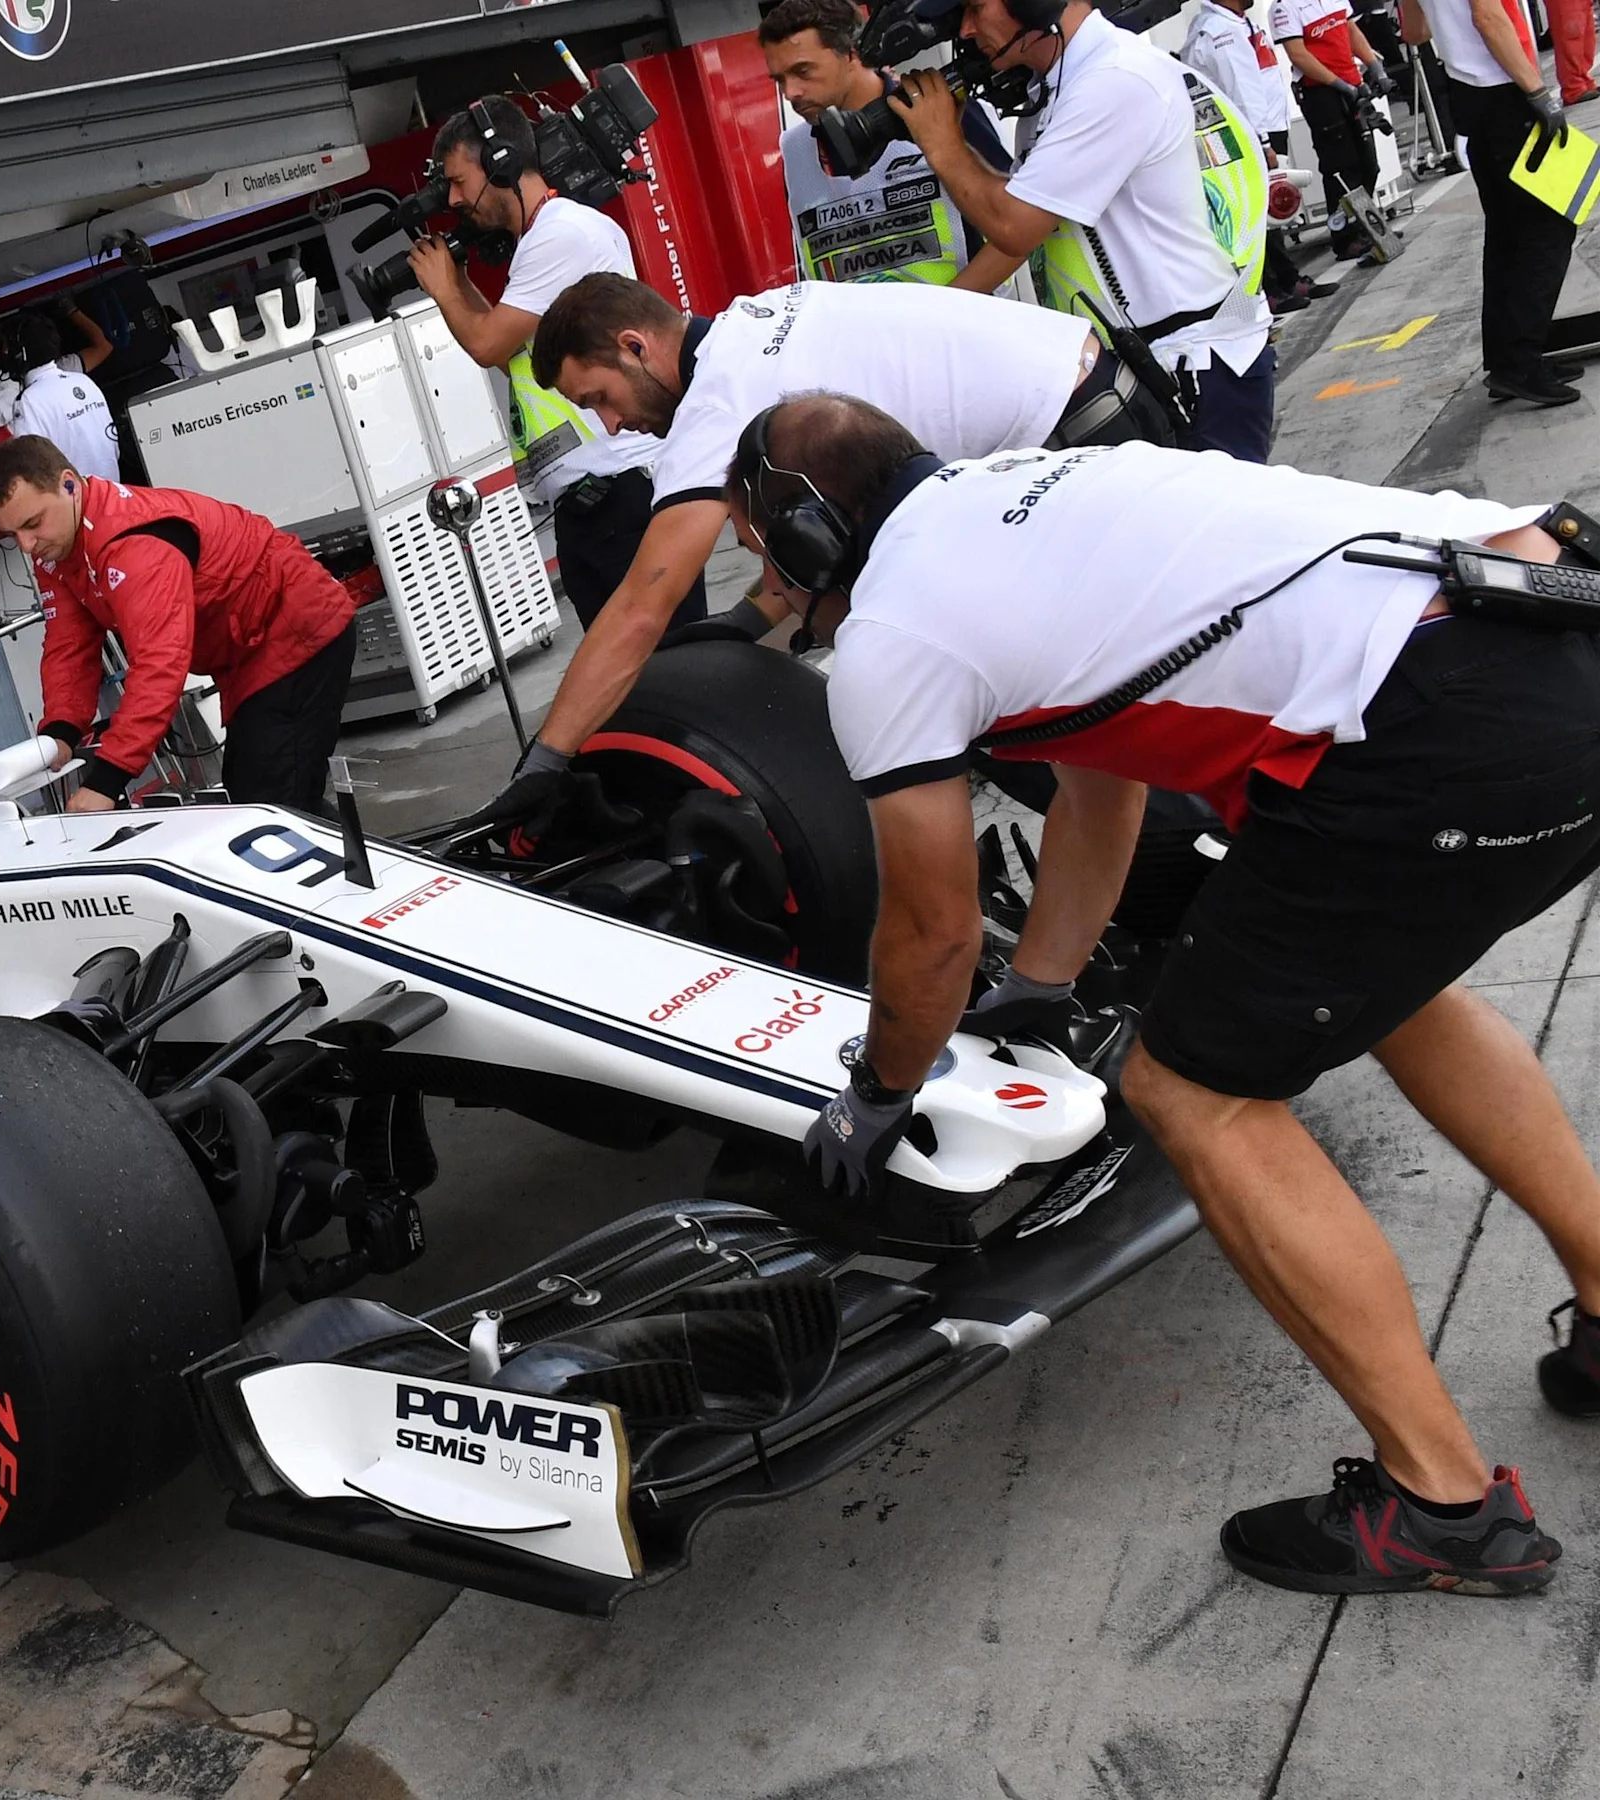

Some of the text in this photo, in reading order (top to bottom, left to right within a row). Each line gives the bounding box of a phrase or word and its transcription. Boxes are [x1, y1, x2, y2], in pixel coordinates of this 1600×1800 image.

[243, 172, 281, 192] Charles
[281, 162, 318, 182] Leclerc
[887, 181, 936, 206] 2018
[653, 203, 671, 233] F1
[836, 224, 871, 244] LANE
[873, 209, 930, 231] ACCESS
[843, 240, 928, 275] MONZA
[664, 238, 693, 321] Sauber
[763, 315, 797, 356] Sauber
[172, 413, 223, 437] Marcus
[225, 394, 289, 421] Ericsson
[1002, 464, 1076, 526] Sauber
[1476, 813, 1594, 847] Sauber F1 Team
[228, 824, 345, 888] 9
[61, 895, 135, 920] MILLE
[360, 876, 463, 930] PIRELLI
[648, 966, 740, 1022] CARRERA
[734, 998, 824, 1053] Claro
[1082, 1147, 1128, 1183] SAFETY
[1038, 1167, 1095, 1209] ACTION
[396, 1383, 602, 1459] POWER
[499, 1448, 522, 1480] by
[529, 1456, 603, 1493] Silanna
